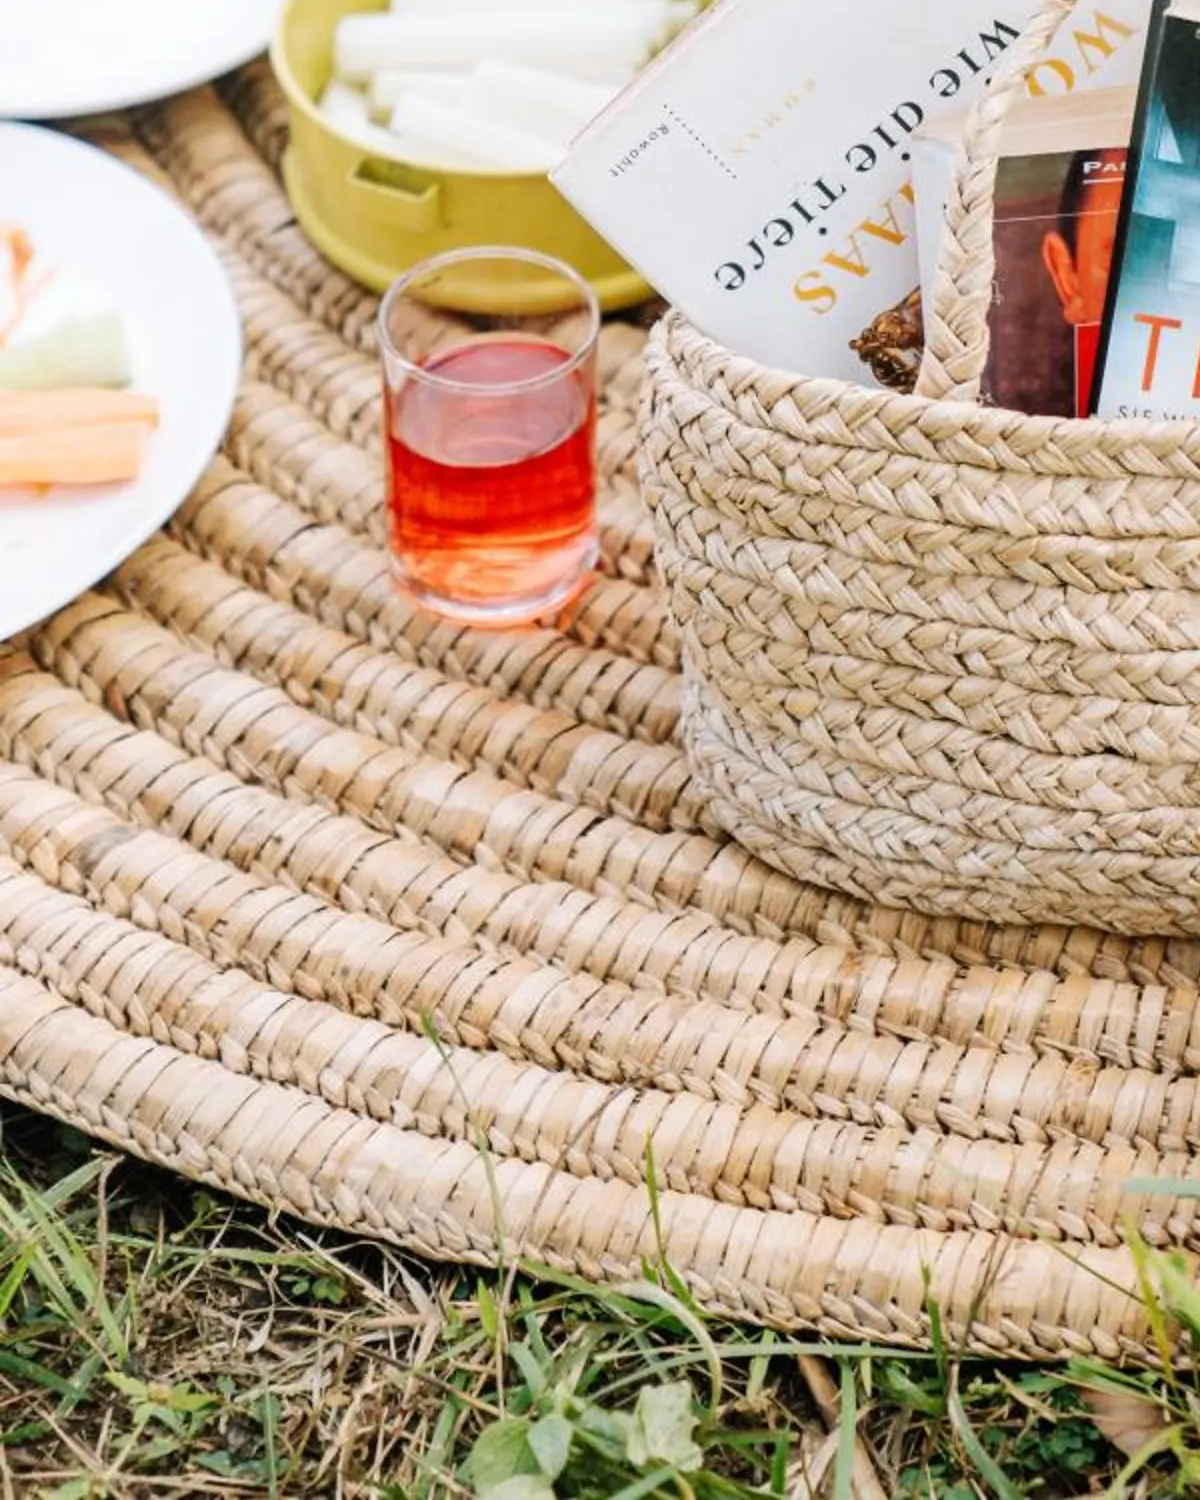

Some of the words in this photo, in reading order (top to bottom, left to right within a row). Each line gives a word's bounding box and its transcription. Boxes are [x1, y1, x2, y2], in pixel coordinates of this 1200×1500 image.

[1023, 8, 1136, 97] WO
[609, 123, 670, 178] Rowohlt
[846, 101, 924, 172] die
[715, 177, 847, 291] Tiere
[794, 182, 915, 314] AAS
